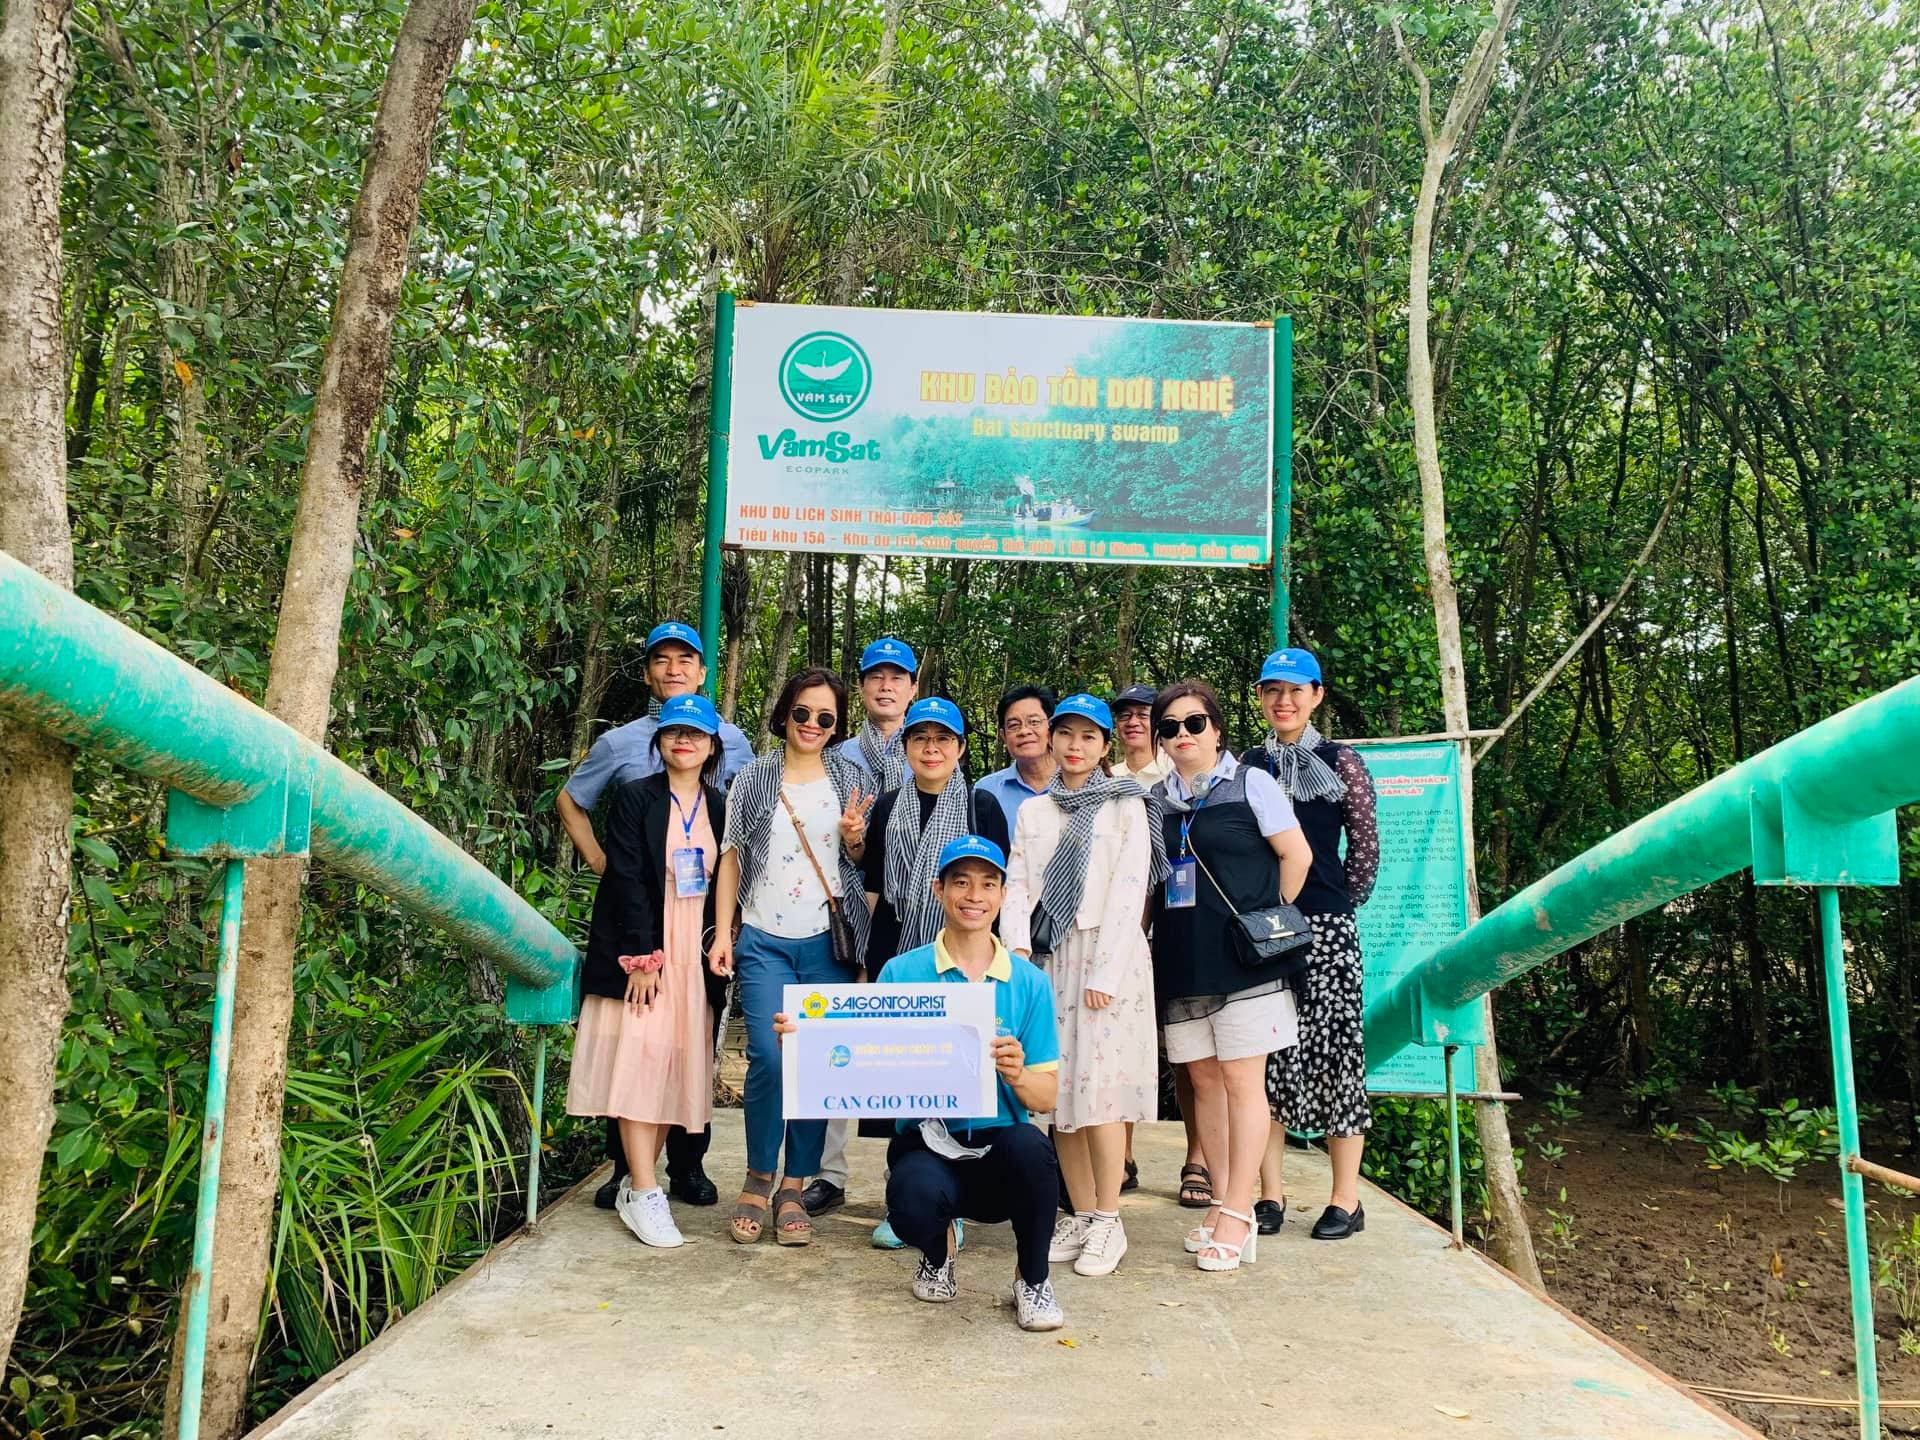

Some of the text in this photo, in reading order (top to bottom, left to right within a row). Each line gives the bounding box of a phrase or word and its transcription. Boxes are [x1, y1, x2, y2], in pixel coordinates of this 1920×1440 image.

[920, 366, 1235, 418] KHU BẢO TỒN DƠI NGHỆ
[973, 417, 1180, 443] Bat sanctuary swamp
[786, 465, 849, 475] ECOPARK
[740, 504, 767, 519] KHU
[772, 506, 790, 520] DU
[831, 508, 862, 523] SINH
[773, 528, 797, 544] khu
[803, 530, 825, 545] 15A
[843, 532, 868, 546] Khu
[832, 995, 946, 1010] SAIGONTOURIST
[824, 1094, 959, 1110] CAN GIO TOUR
